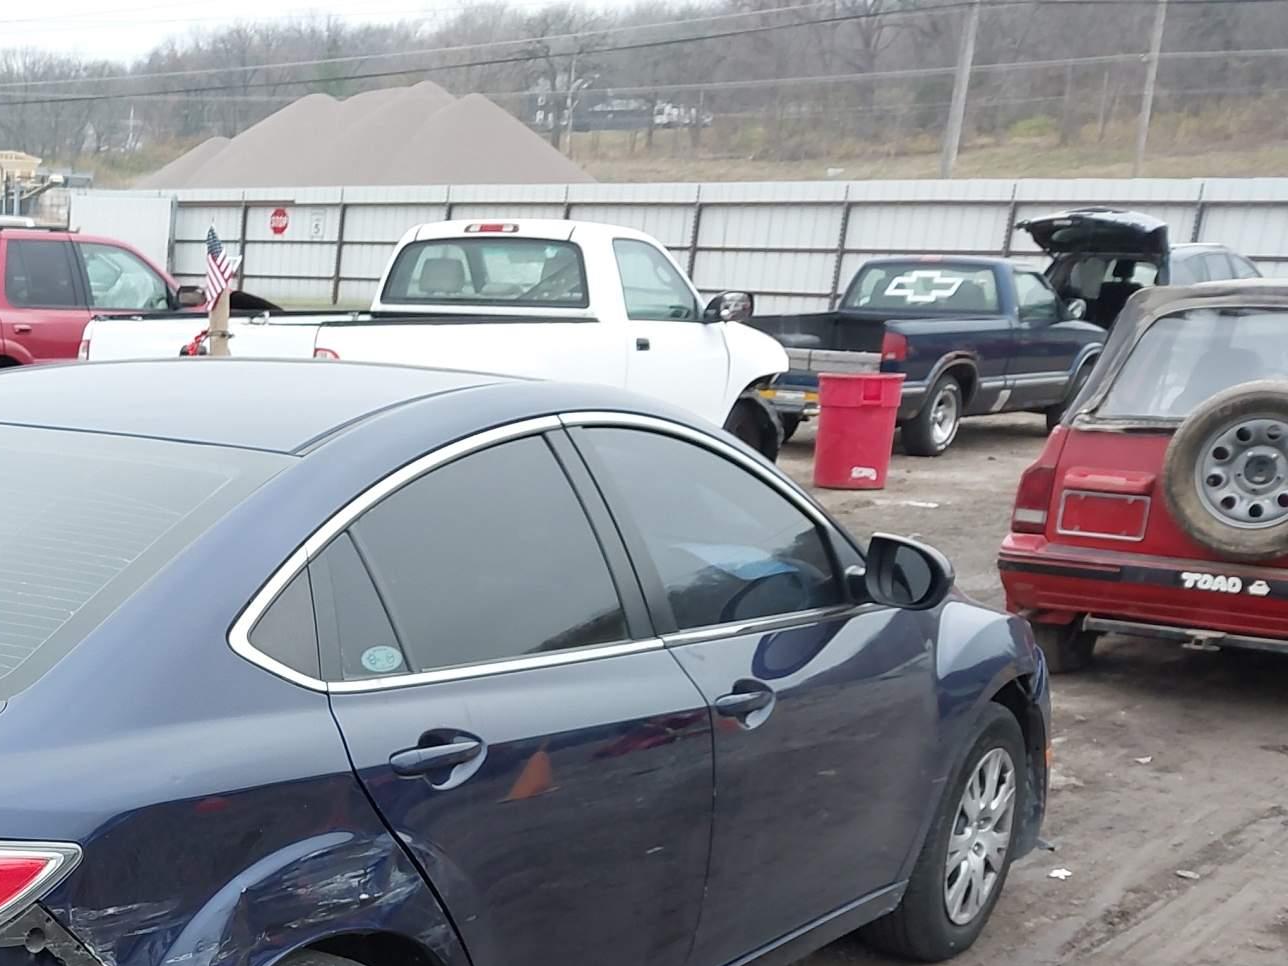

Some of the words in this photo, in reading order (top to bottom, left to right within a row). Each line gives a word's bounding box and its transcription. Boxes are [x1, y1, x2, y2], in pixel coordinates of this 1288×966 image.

[271, 215, 288, 228] STOP
[313, 223, 321, 234] 5
[1181, 571, 1243, 594] TOAD
